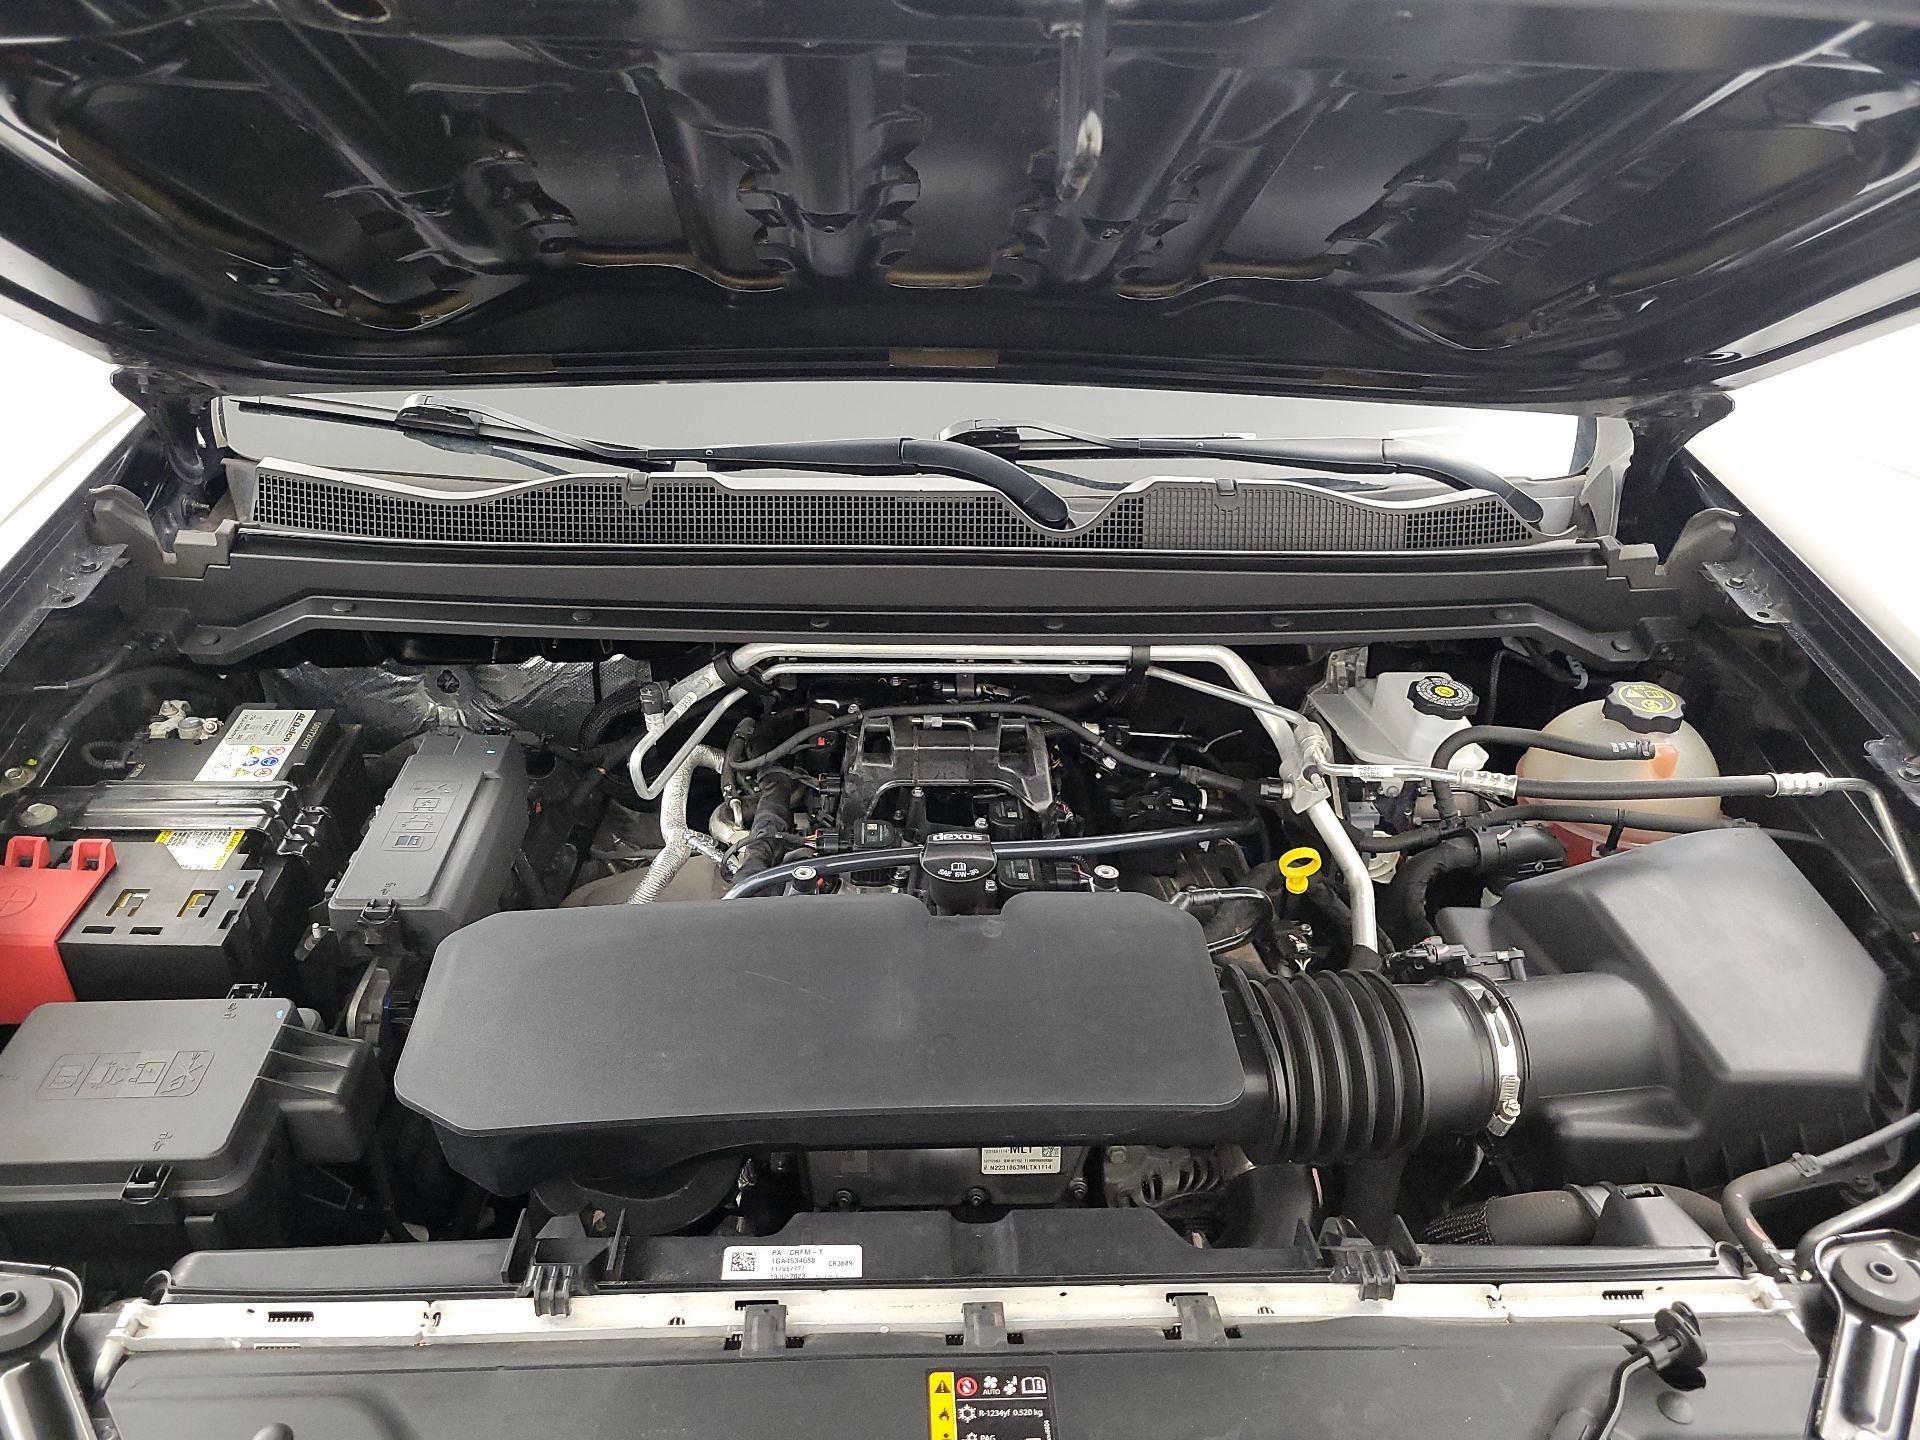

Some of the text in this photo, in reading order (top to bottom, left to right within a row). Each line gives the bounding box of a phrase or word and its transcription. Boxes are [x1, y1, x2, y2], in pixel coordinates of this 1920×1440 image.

[932, 832, 983, 841] dexos
[938, 868, 952, 877] SAE
[979, 1408, 1043, 1418] R-1234yf 0.520 kg
